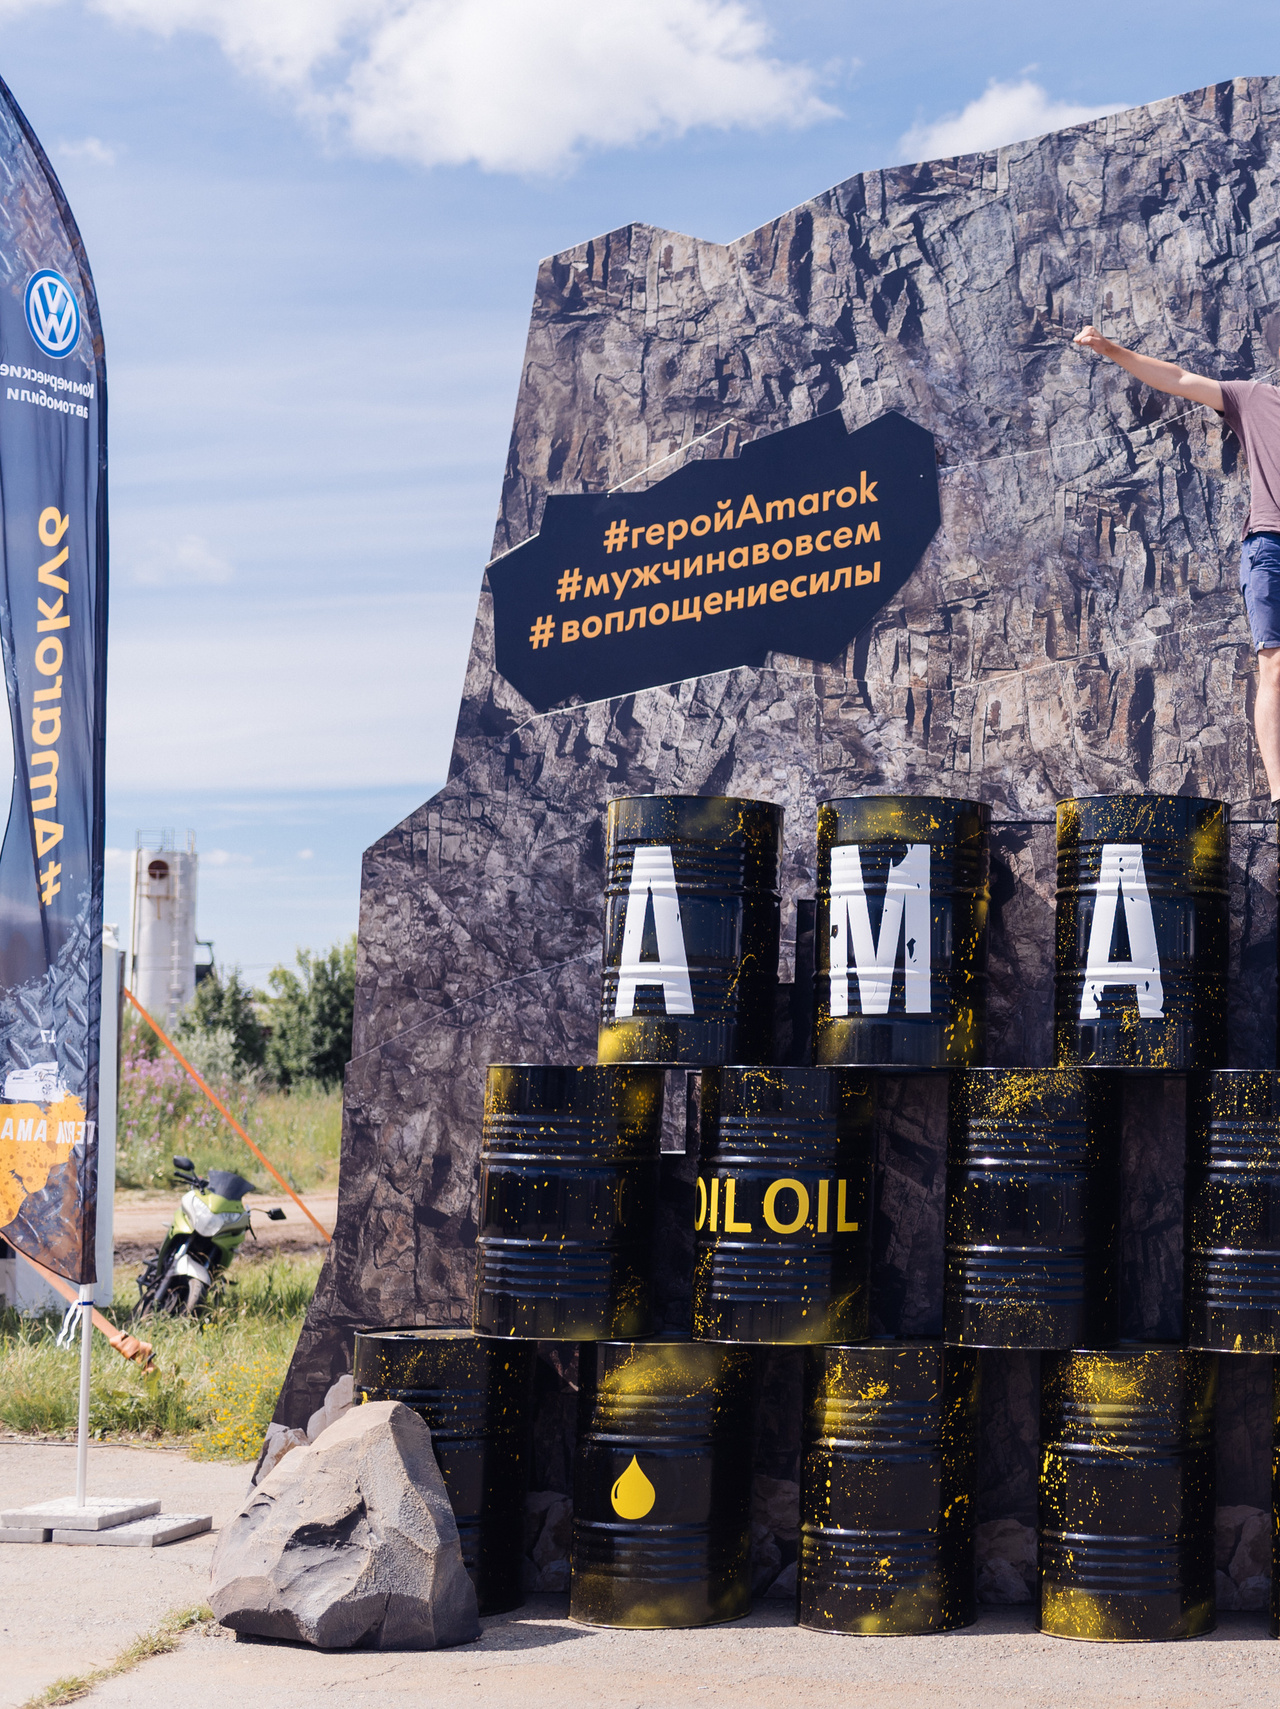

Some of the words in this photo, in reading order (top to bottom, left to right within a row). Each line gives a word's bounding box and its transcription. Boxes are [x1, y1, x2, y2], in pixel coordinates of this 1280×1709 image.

[603, 470, 879, 554] #геройAmarok
[556, 520, 881, 602] #мужчинавовсем
[694, 1176, 752, 1233] OIL
[763, 1178, 859, 1234] OIL
